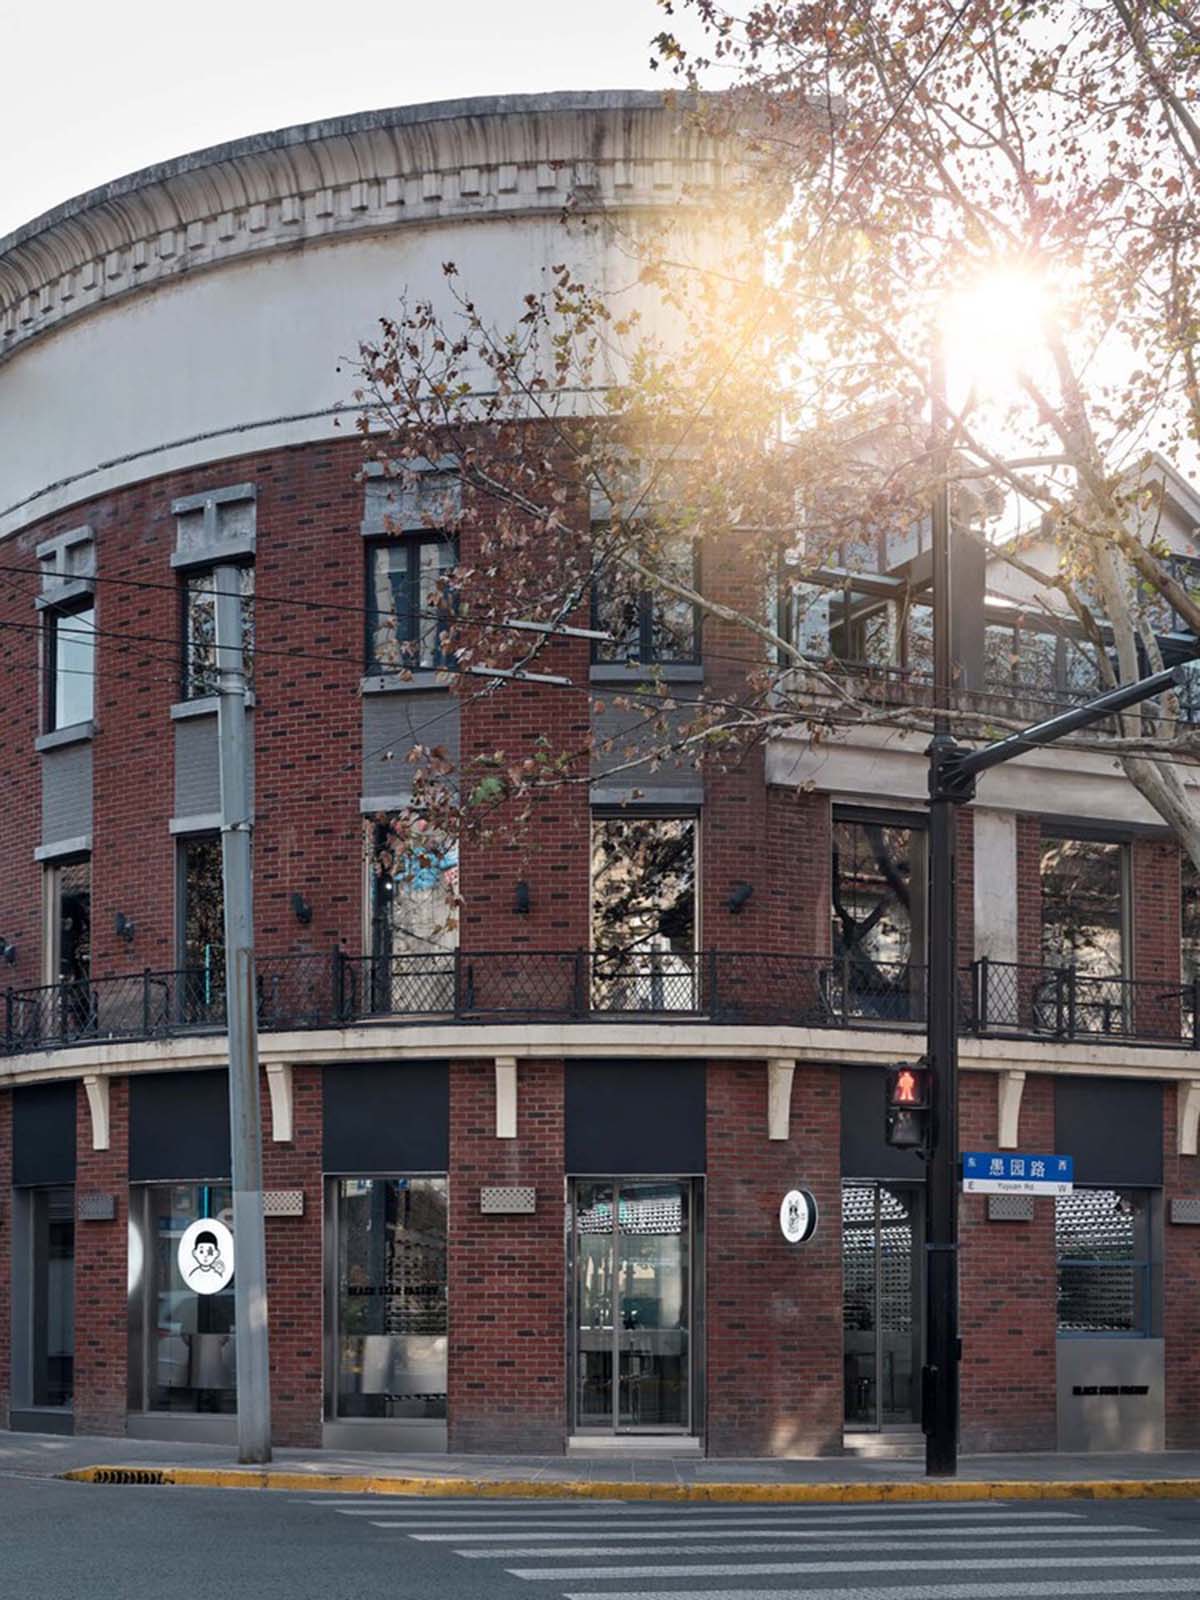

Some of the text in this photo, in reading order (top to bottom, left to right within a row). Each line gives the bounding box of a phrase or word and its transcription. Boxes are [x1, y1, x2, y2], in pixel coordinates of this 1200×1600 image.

[989, 1158, 1045, 1177] 愚园路
[967, 1181, 975, 1190] E
[1024, 1183, 1034, 1191] Rd
[1057, 1184, 1067, 1192] W
